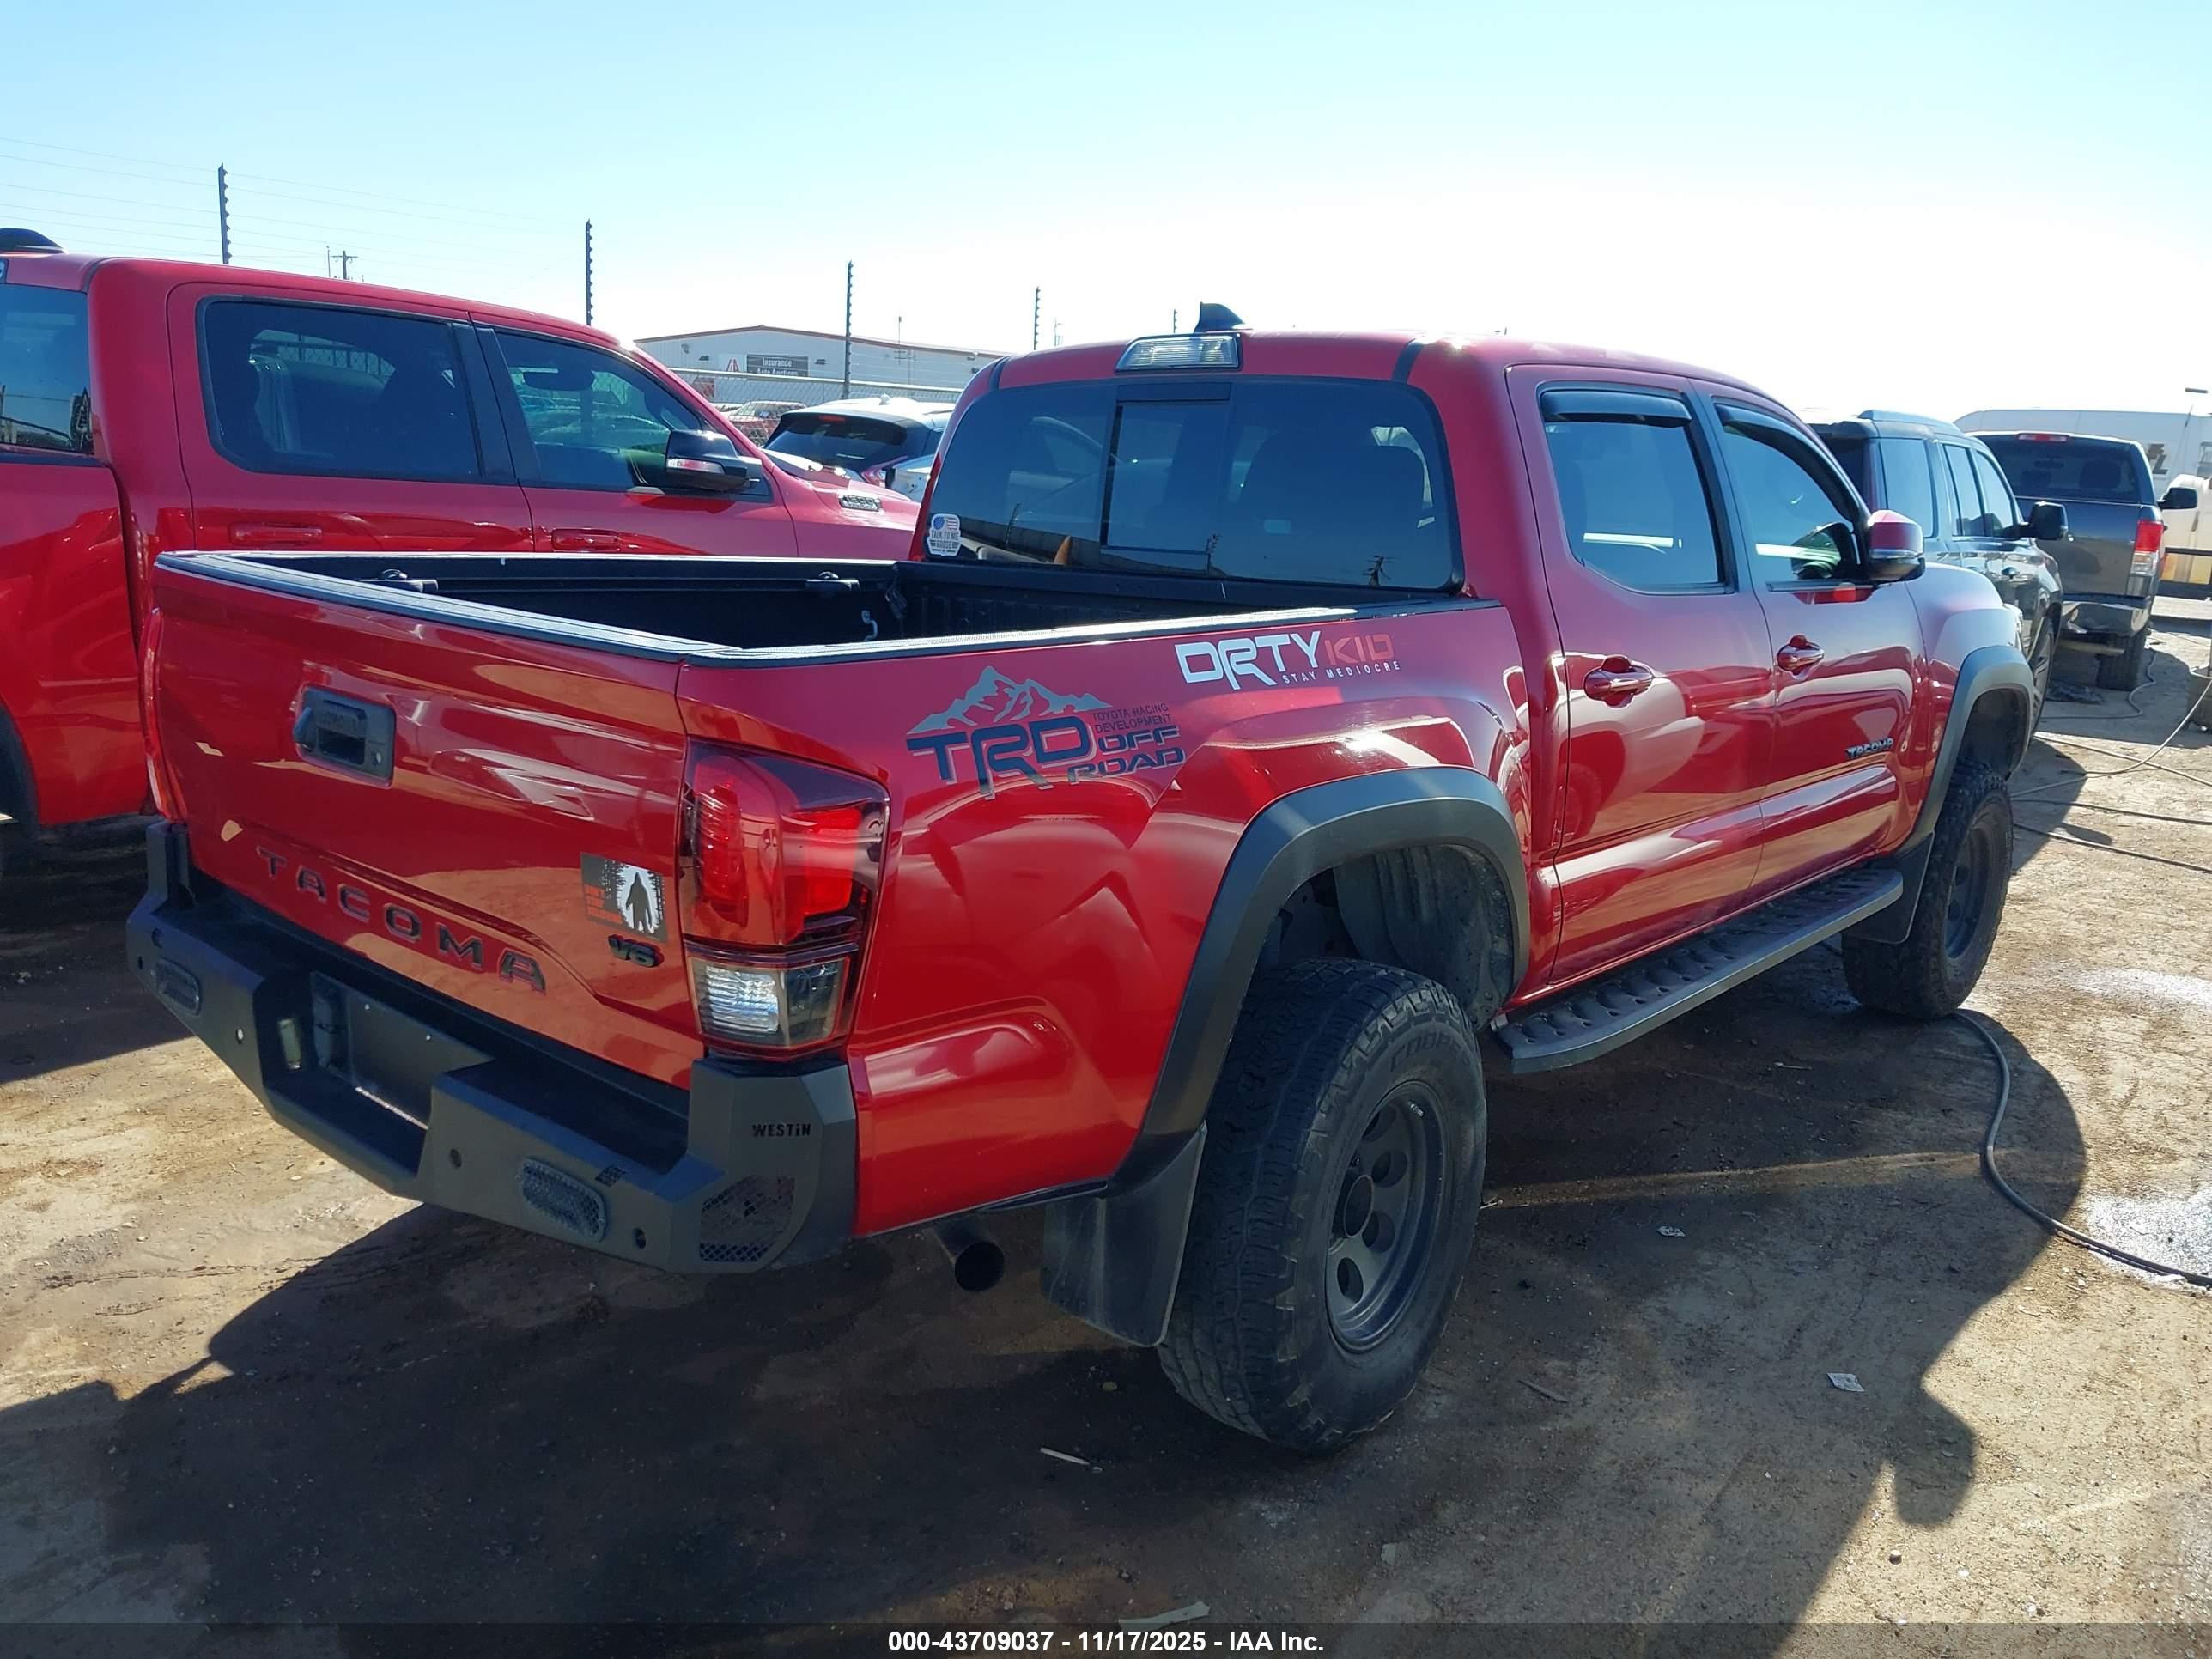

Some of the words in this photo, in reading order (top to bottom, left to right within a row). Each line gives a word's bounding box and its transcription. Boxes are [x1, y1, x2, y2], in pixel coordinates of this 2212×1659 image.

[762, 356, 793, 368] Insurance
[943, 531, 951, 540] TO
[1174, 631, 1321, 690] DRTY
[1324, 634, 1395, 665] KID
[1282, 672, 1317, 684] STAY
[1326, 660, 1401, 680] MEDIOCRE
[1091, 708, 1131, 722] TOYOTA
[1132, 702, 1169, 716] RACING
[1094, 714, 1173, 733] DEVELOPMENT
[1097, 725, 1181, 756] OFF
[906, 715, 1097, 800] TRD
[1066, 746, 1187, 784] ROAD
[257, 845, 547, 996] TACOMA
[608, 934, 661, 968] V6
